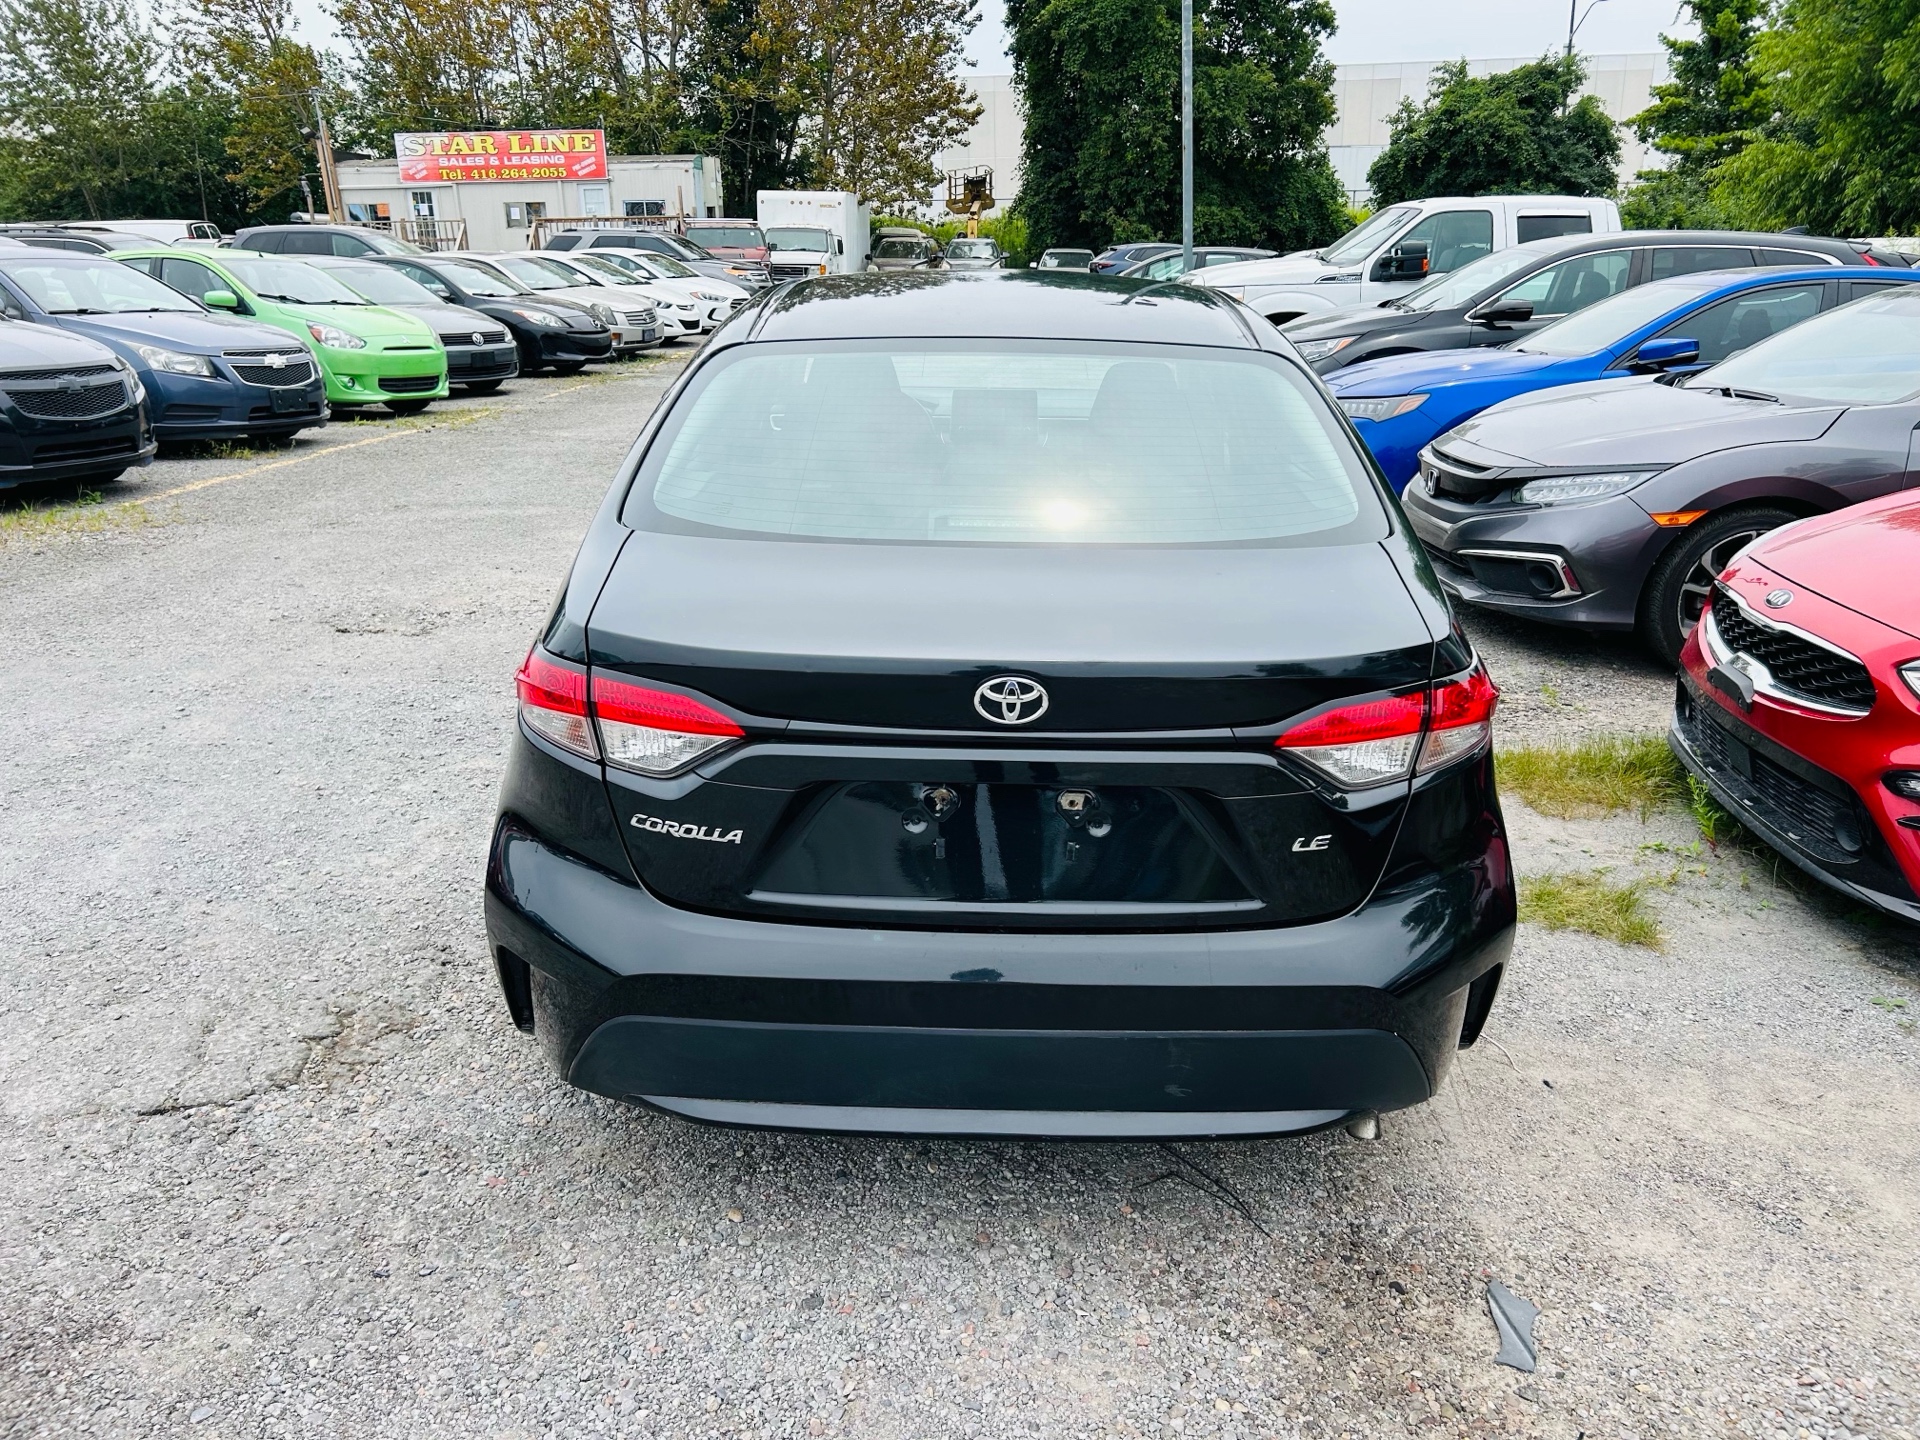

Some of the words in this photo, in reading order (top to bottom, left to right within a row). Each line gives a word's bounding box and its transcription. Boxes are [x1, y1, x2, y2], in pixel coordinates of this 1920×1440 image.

[403, 134, 499, 156] STAR
[507, 133, 597, 154] LINE
[438, 157, 485, 167] SALES
[489, 156, 500, 166] &
[503, 154, 566, 165] LEASING
[439, 168, 467, 180] Tel:
[470, 167, 567, 180] 416.264.2055
[630, 813, 744, 844] COROLLA
[1291, 834, 1333, 852] LE
